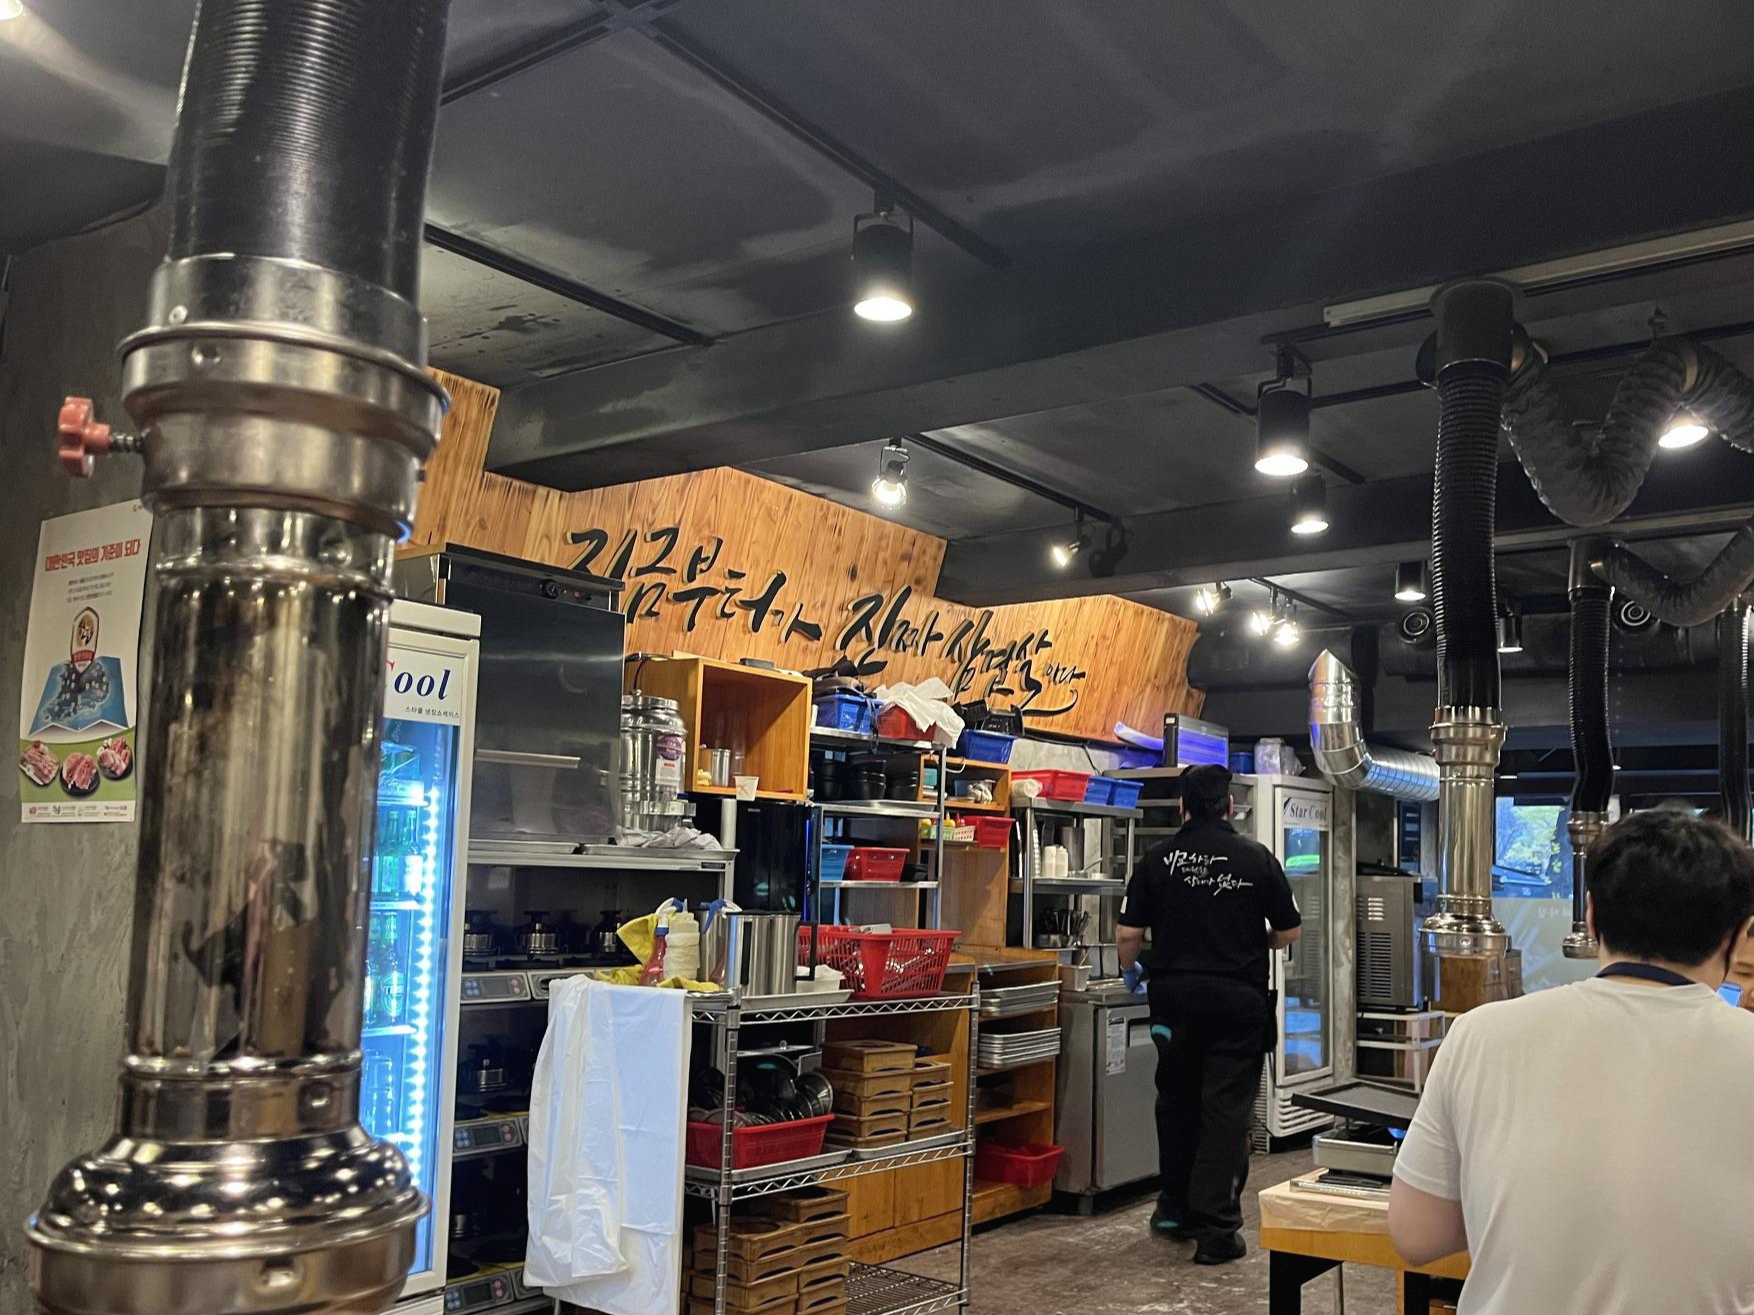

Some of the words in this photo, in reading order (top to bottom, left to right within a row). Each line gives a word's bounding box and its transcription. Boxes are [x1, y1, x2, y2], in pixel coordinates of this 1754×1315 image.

[124, 538, 141, 557] 되다
[835, 584, 944, 676] 진짜
[385, 661, 451, 701] ool
[1290, 803, 1307, 819] Star
[1309, 805, 1327, 821] Cool
